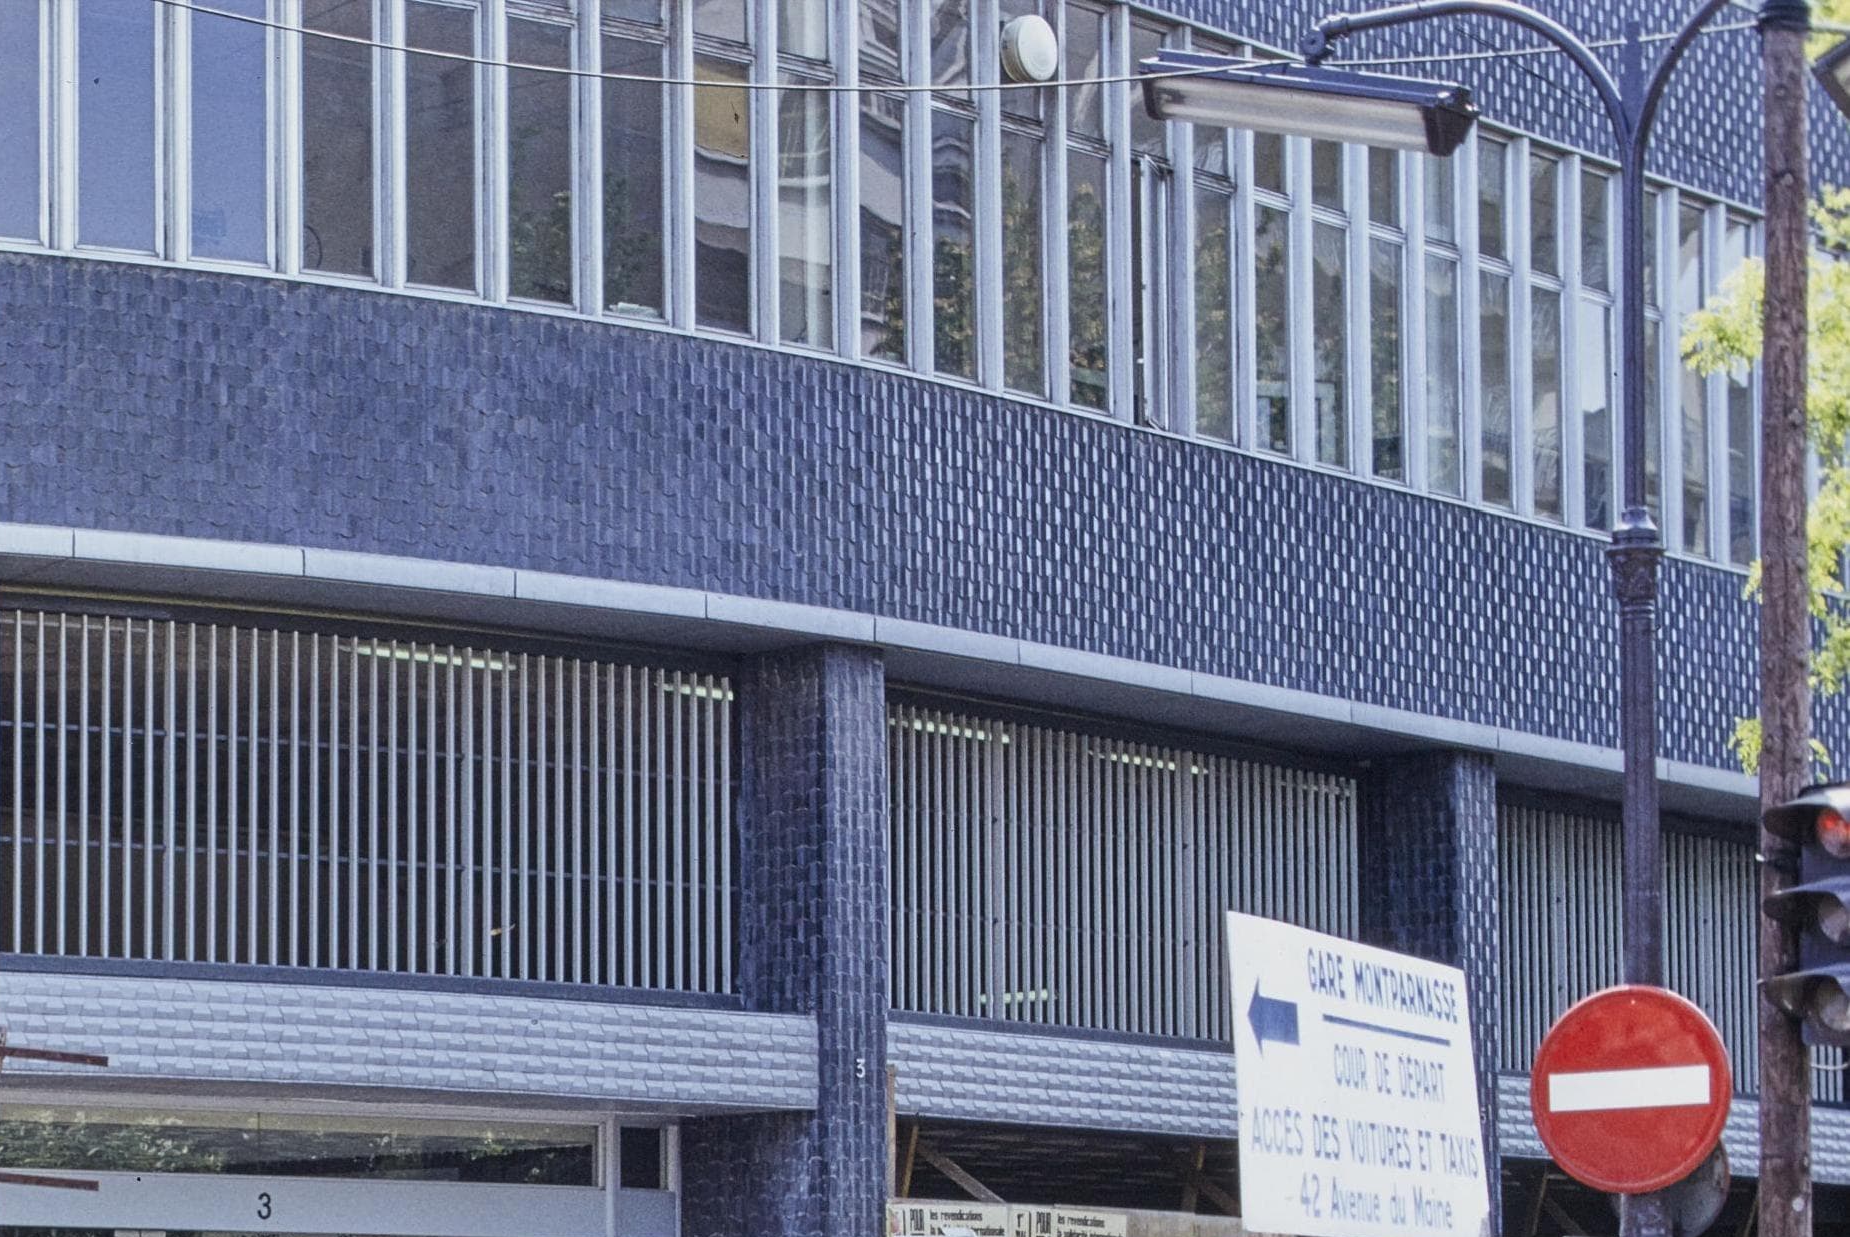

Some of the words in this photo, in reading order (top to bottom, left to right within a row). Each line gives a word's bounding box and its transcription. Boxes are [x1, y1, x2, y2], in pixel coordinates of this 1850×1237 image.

[1306, 947, 1346, 999] GARE
[1353, 959, 1459, 1025] MONTPARNASSE
[856, 1058, 866, 1078] 3
[1333, 1042, 1369, 1092] COUR
[1374, 1049, 1393, 1096] DE
[1312, 1112, 1341, 1162] DES
[1347, 1118, 1413, 1171] VOITURES
[1417, 1129, 1433, 1173] ET
[1439, 1132, 1480, 1179] TAXIS
[257, 1192, 272, 1220] 3
[1300, 1172, 1322, 1219] 42
[1330, 1175, 1382, 1224] Avenue
[1390, 1181, 1407, 1228] du
[910, 1209, 924, 1231] POUR
[941, 1210, 983, 1221] revendications
[1036, 1211, 1051, 1234] POUR
